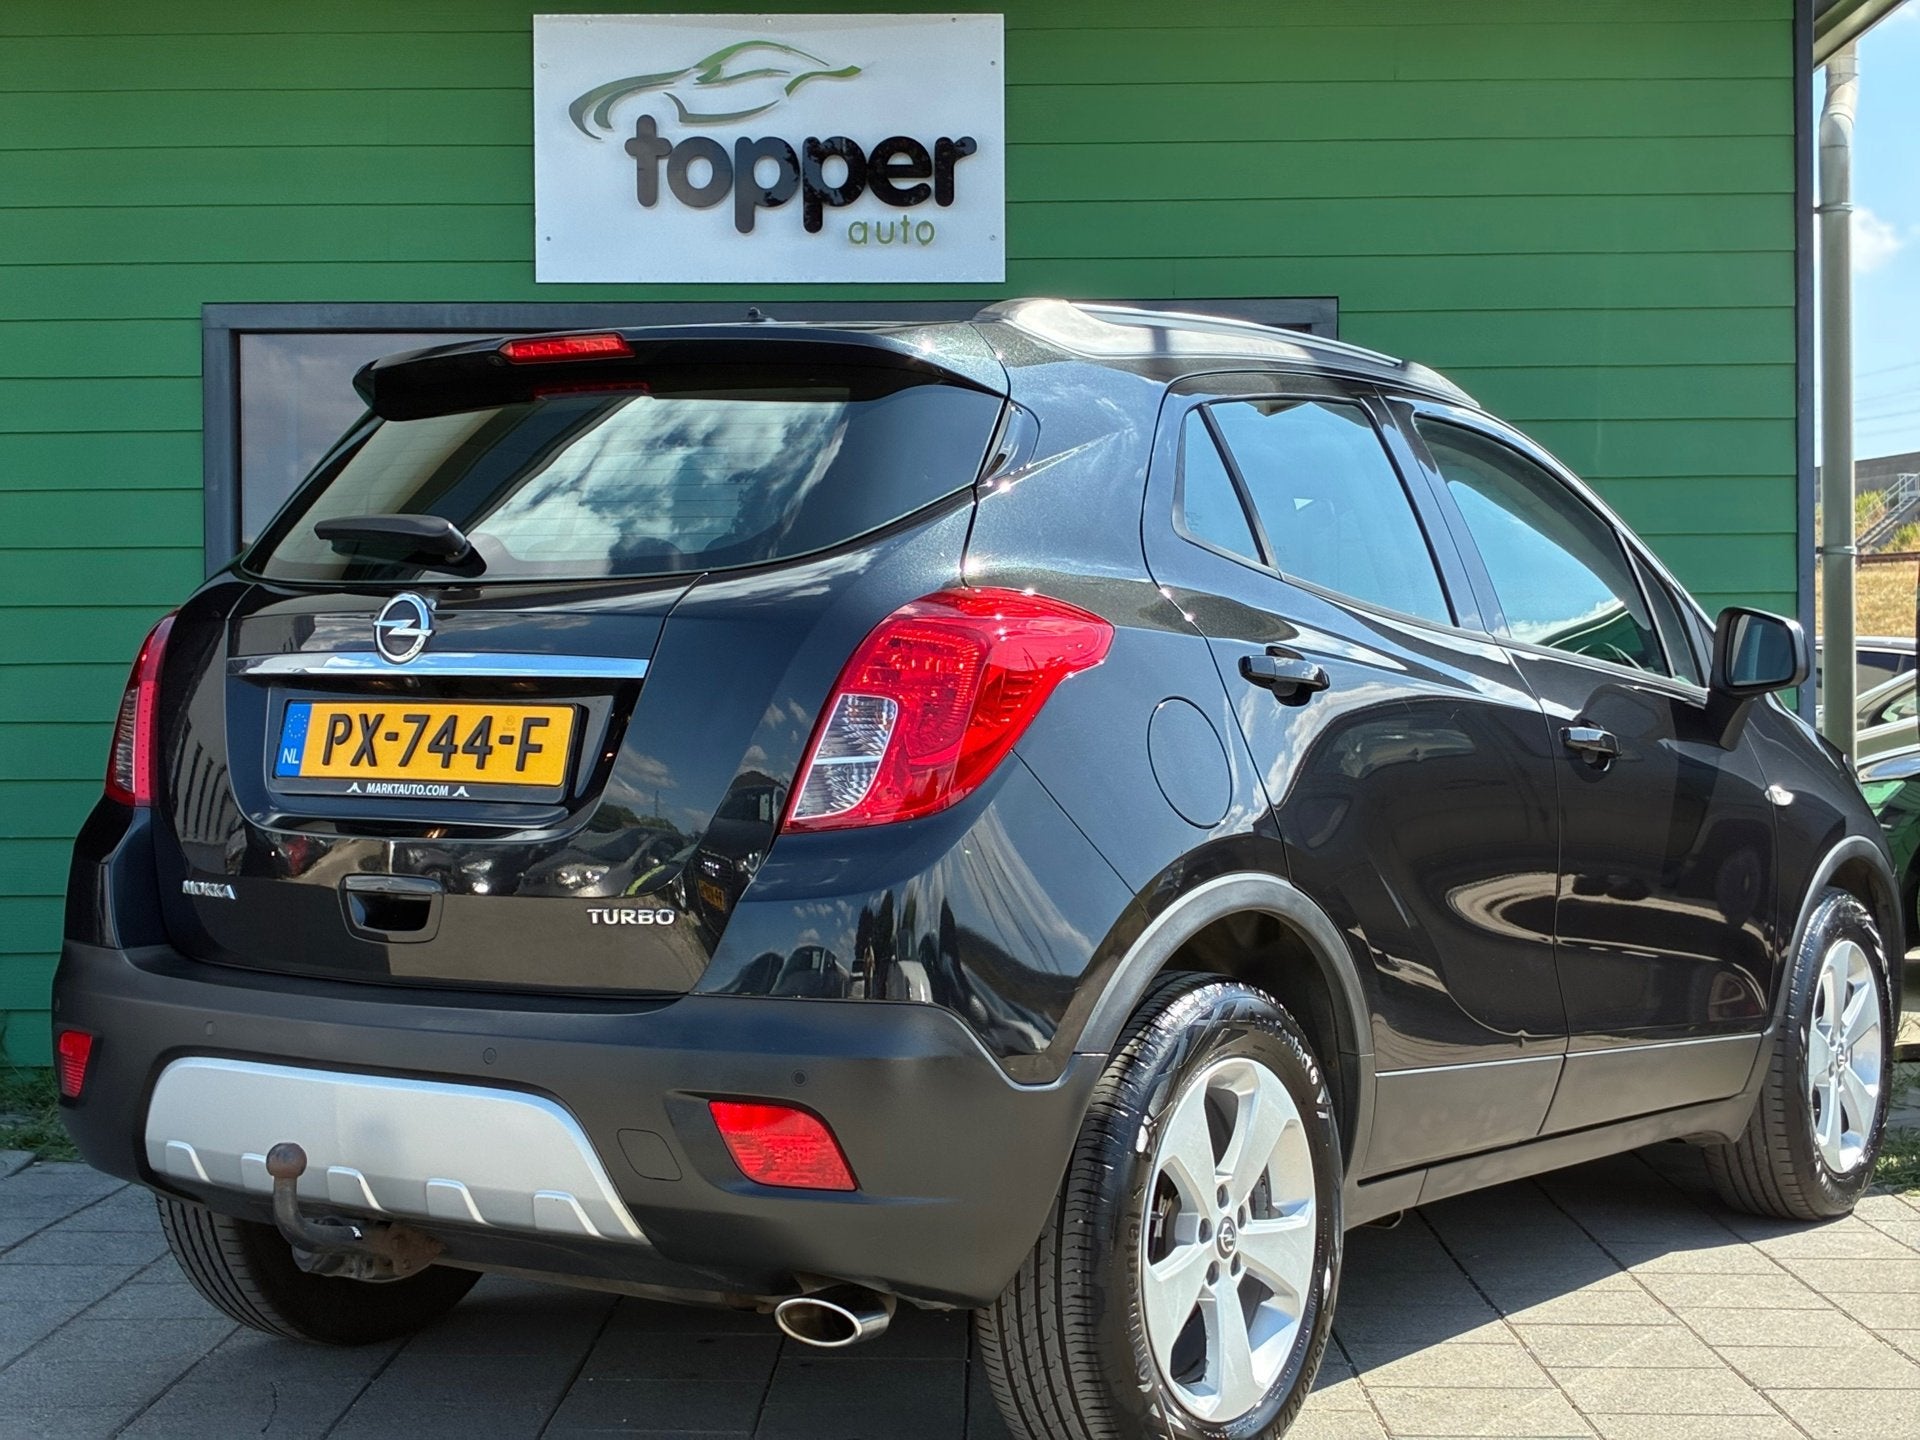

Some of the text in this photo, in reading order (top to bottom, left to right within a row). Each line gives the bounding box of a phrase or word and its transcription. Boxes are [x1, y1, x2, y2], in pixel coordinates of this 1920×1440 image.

[624, 114, 978, 234] topper
[848, 215, 937, 247] auto
[321, 713, 550, 772] PX-744-F
[282, 748, 300, 764] NL
[366, 782, 449, 797] MARKTAUTO.COM
[587, 908, 675, 925] TURBO
